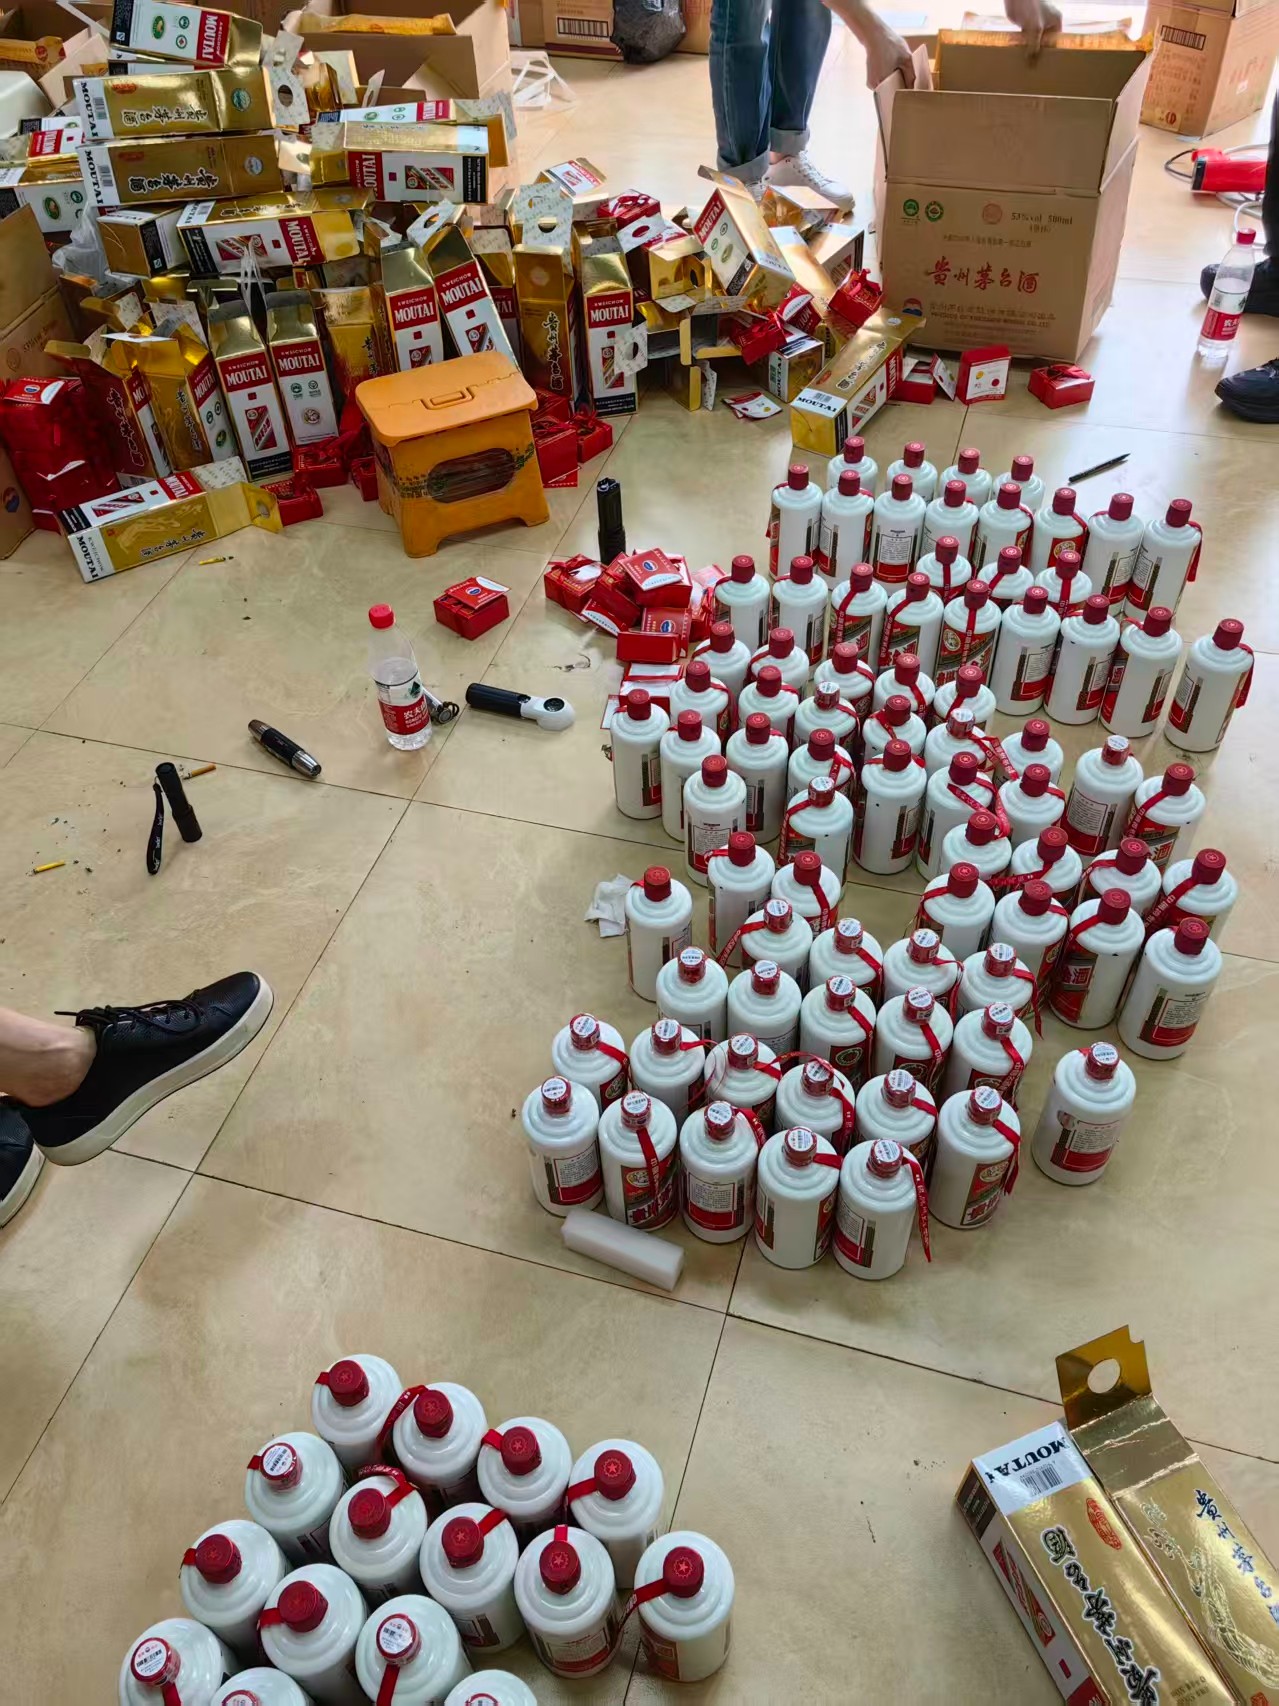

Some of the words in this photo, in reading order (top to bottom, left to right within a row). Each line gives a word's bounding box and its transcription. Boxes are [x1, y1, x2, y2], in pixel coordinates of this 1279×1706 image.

[202, 14, 218, 59] MOUTAI
[80, 81, 98, 138] MOUTAI
[85, 149, 104, 204] MOUTAI
[362, 154, 378, 197] OUTAI
[286, 220, 311, 264] MOUTAI
[441, 278, 482, 306] MOUTAI
[925, 255, 1040, 294] 贵州茅台酒
[394, 302, 435, 323] MOUTAI
[590, 305, 629, 322] MOUTAI
[225, 365, 268, 386] MOUTAI
[278, 353, 320, 371] MOUTAI
[797, 397, 838, 413] MOUTAI
[76, 535, 99, 579] MOUTAI
[985, 1436, 1067, 1484] MOUTAI
